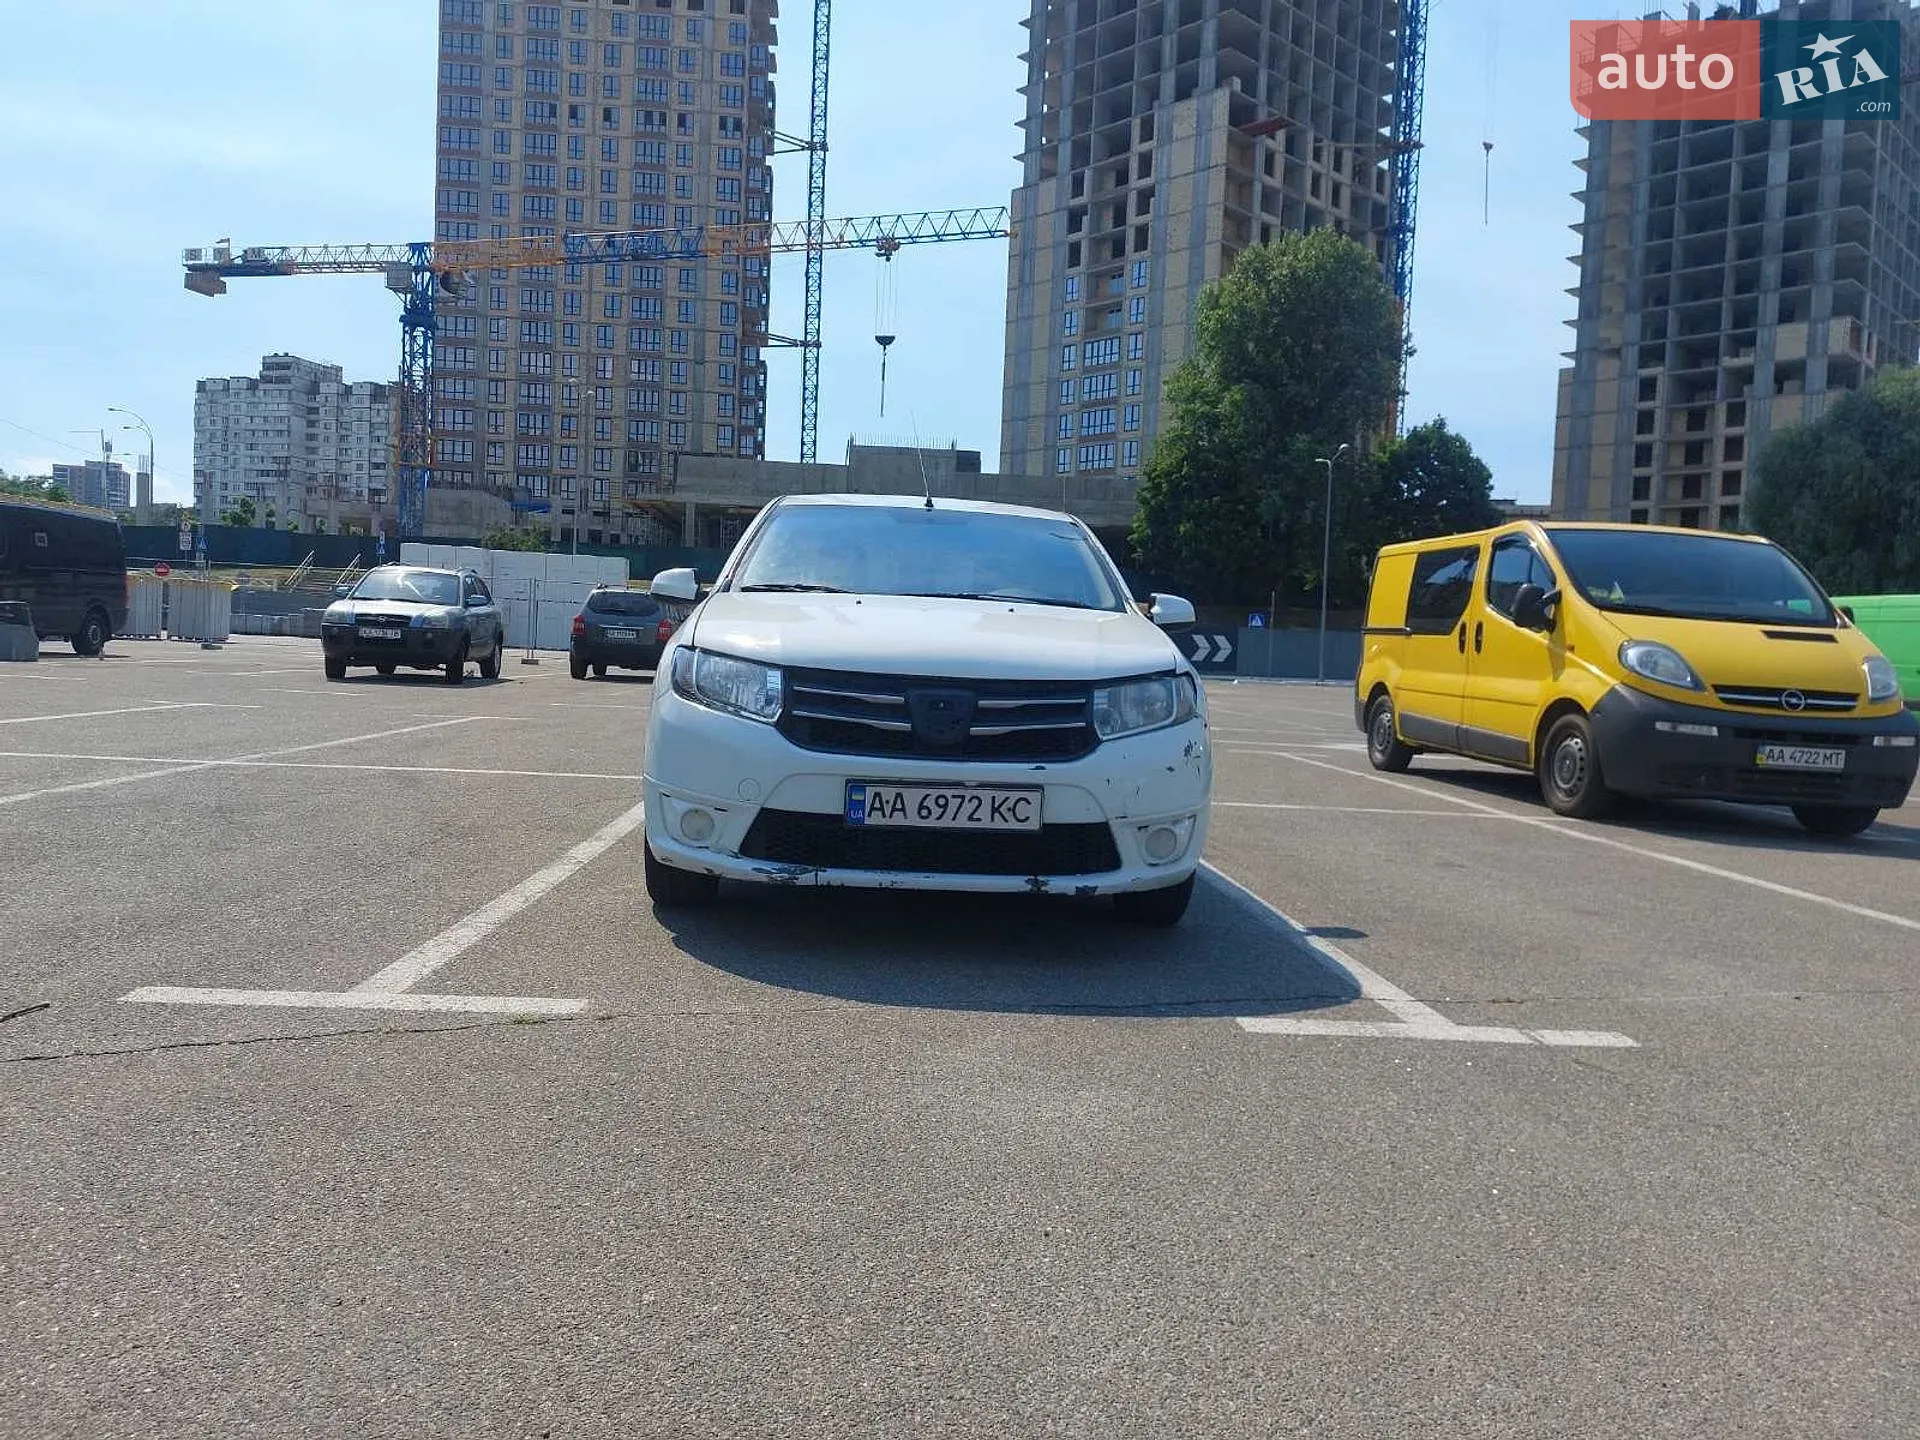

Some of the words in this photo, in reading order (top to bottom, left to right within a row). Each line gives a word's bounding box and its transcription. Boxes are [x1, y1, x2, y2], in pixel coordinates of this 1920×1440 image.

[1766, 748, 1785, 763] AA
[1789, 749, 1820, 765] 4722
[1822, 751, 1842, 766] MT
[867, 791, 908, 820] AA
[917, 793, 982, 822] 6972
[991, 795, 1032, 824] KC
